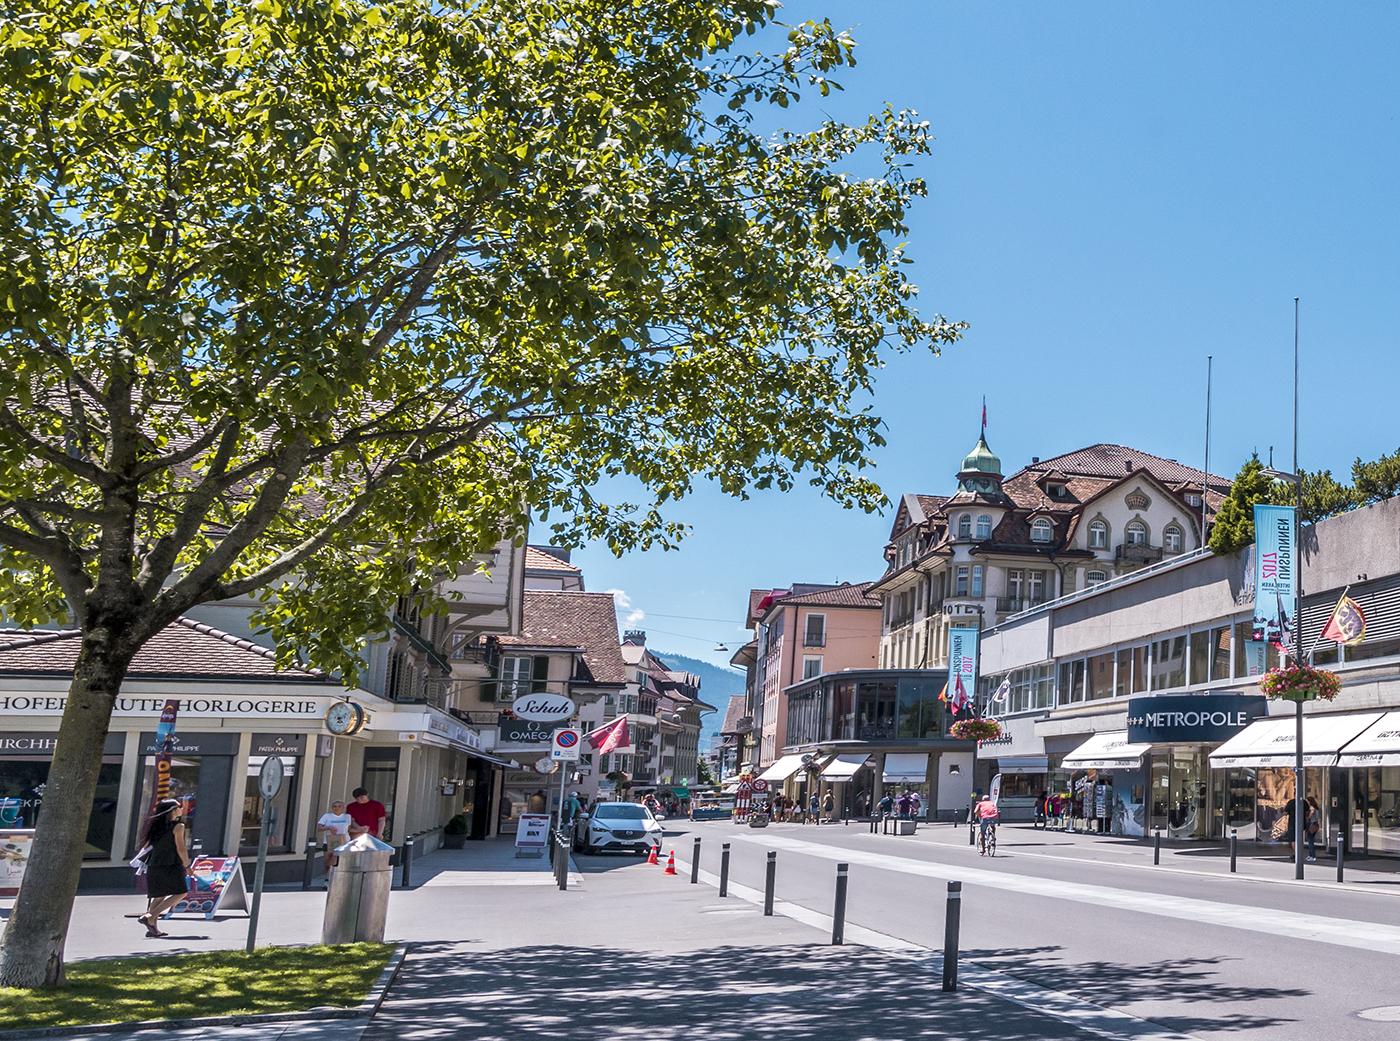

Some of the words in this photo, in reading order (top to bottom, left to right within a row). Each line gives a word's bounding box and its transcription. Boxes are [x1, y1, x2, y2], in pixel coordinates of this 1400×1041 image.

[962, 656, 973, 673] 2017
[177, 698, 316, 713] HORLOGERIE
[517, 700, 569, 714] Schuh
[1145, 711, 1247, 727] METROPOLE
